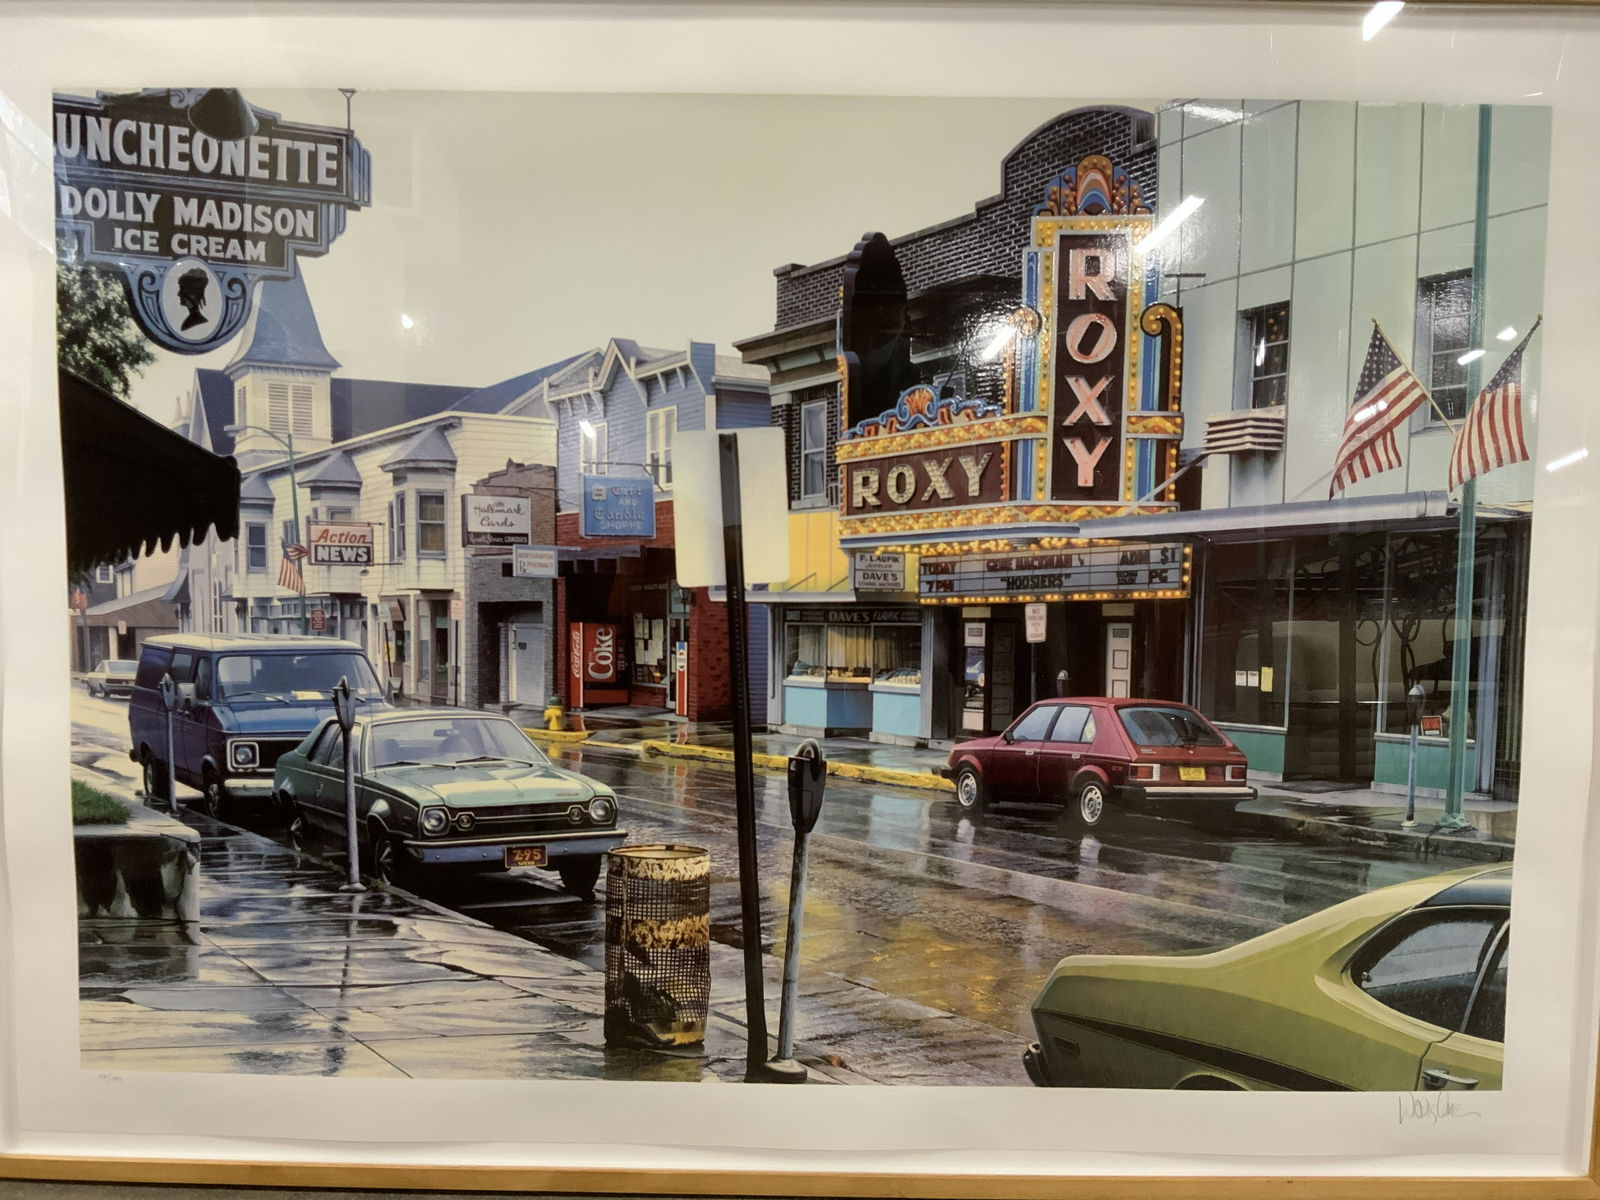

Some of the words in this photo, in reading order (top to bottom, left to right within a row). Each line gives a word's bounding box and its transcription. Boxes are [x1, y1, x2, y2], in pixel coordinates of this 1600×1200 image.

[60, 185, 162, 225] DOLLY
[173, 196, 315, 239] MADISON
[113, 227, 160, 252] ICE
[170, 233, 267, 262] CREAM
[1062, 247, 1118, 488] ROXY
[852, 452, 993, 509] ROXY
[474, 503, 526, 516] Hallmark
[480, 516, 515, 527] Cards
[316, 527, 368, 545] Action
[317, 545, 369, 563] NEWS
[828, 610, 870, 622] DAVE'S
[587, 627, 614, 680] Coke
